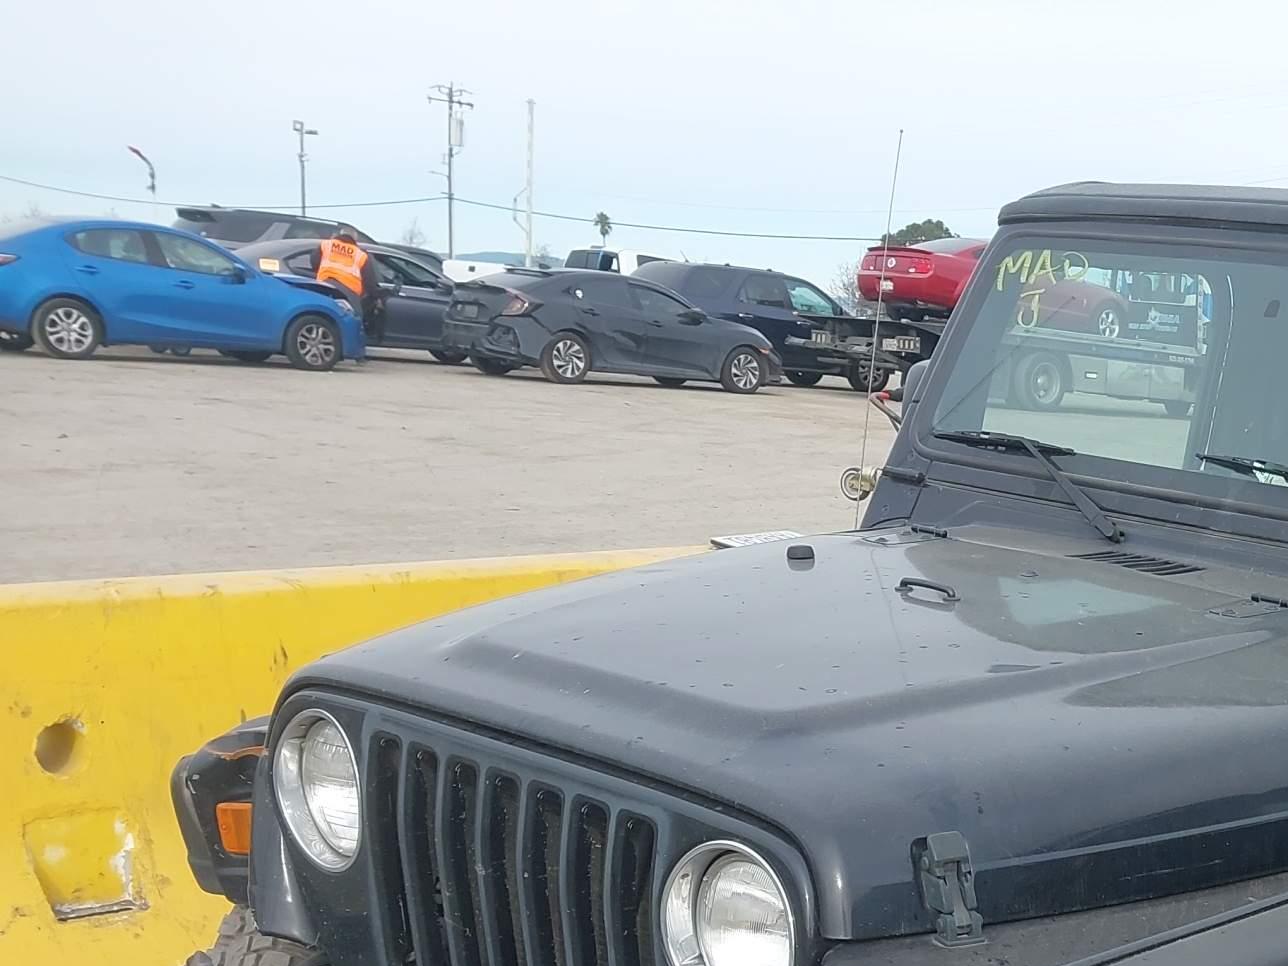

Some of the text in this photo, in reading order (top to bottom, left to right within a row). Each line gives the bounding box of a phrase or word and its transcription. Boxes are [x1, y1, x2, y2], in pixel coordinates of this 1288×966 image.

[332, 243, 354, 255] MAD
[997, 249, 1089, 291] MAD
[1018, 288, 1046, 328] J
